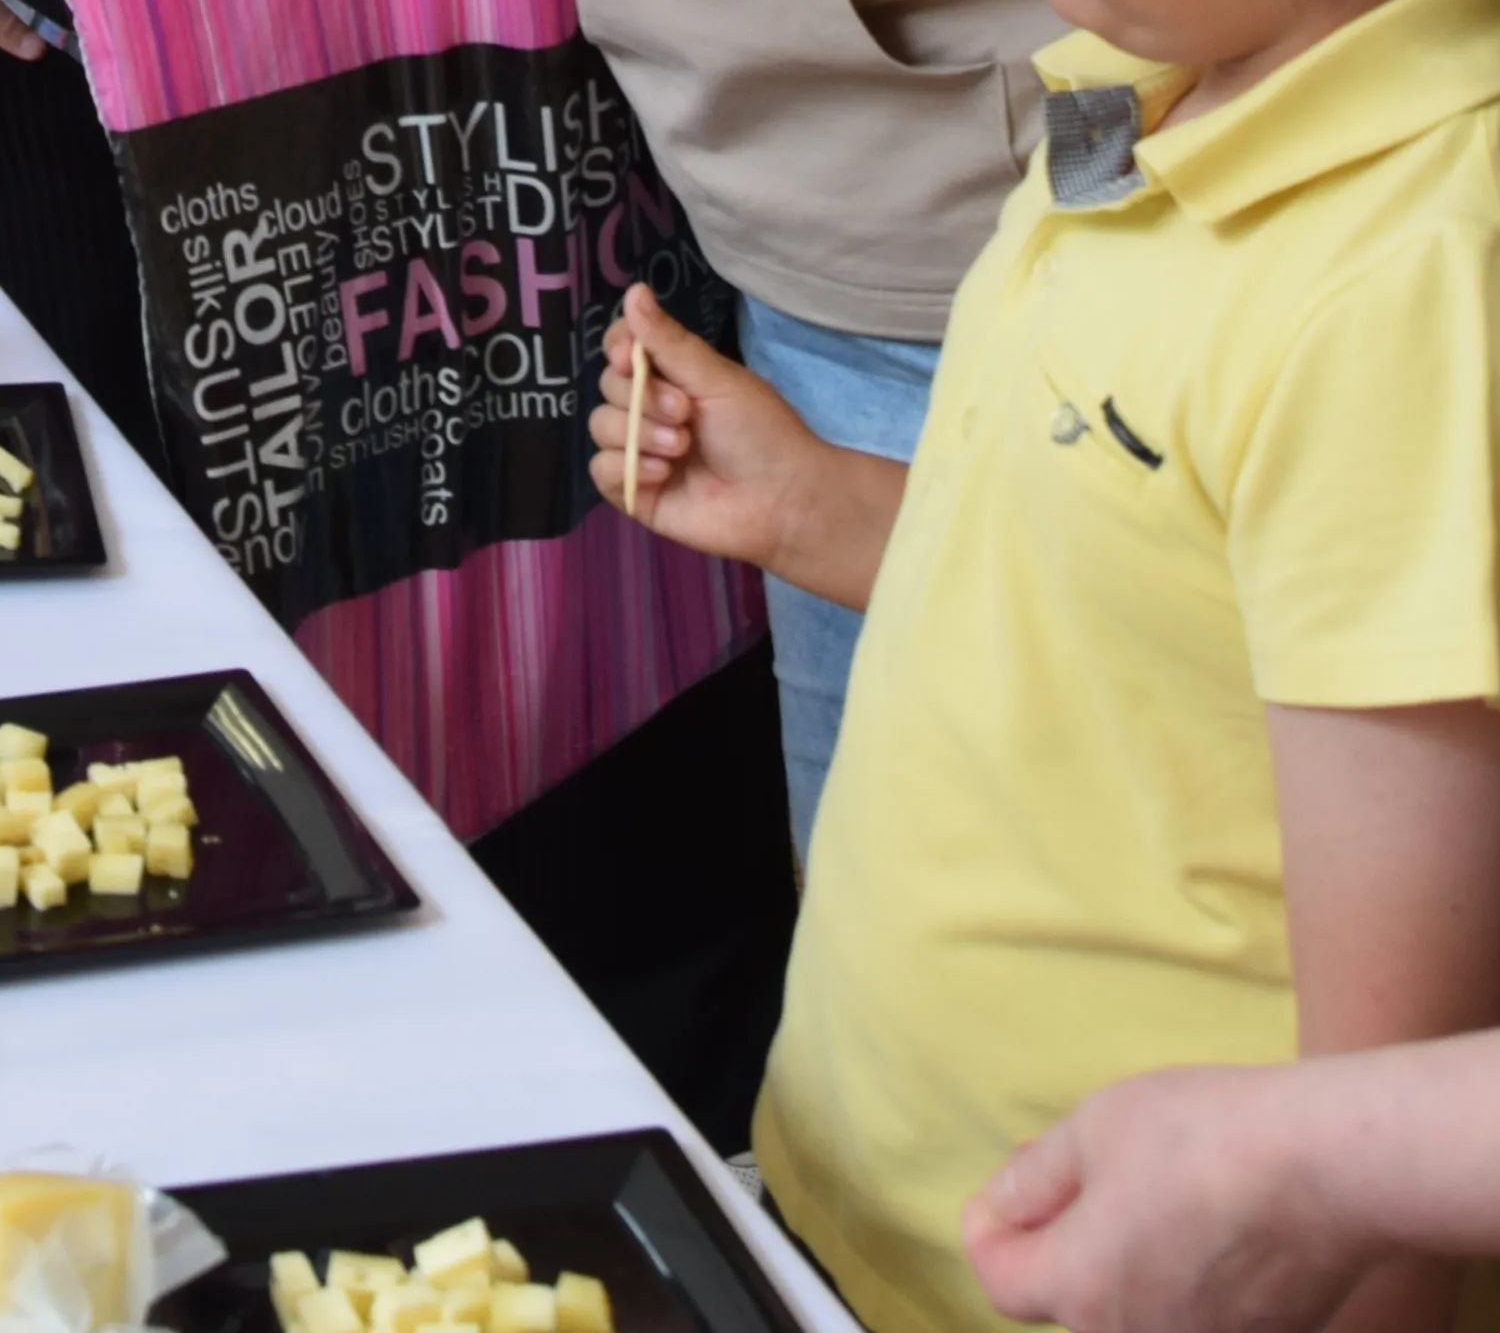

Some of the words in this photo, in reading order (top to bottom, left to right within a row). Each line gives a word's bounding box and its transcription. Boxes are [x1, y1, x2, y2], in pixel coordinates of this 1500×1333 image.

[160, 181, 260, 235] cloths
[260, 179, 343, 238] cloud
[182, 233, 228, 318] silk
[313, 227, 348, 373] beauty
[221, 217, 307, 529] TAILOR
[340, 363, 463, 435] cloths
[183, 318, 264, 543] SUITS
[420, 408, 455, 527] coats
